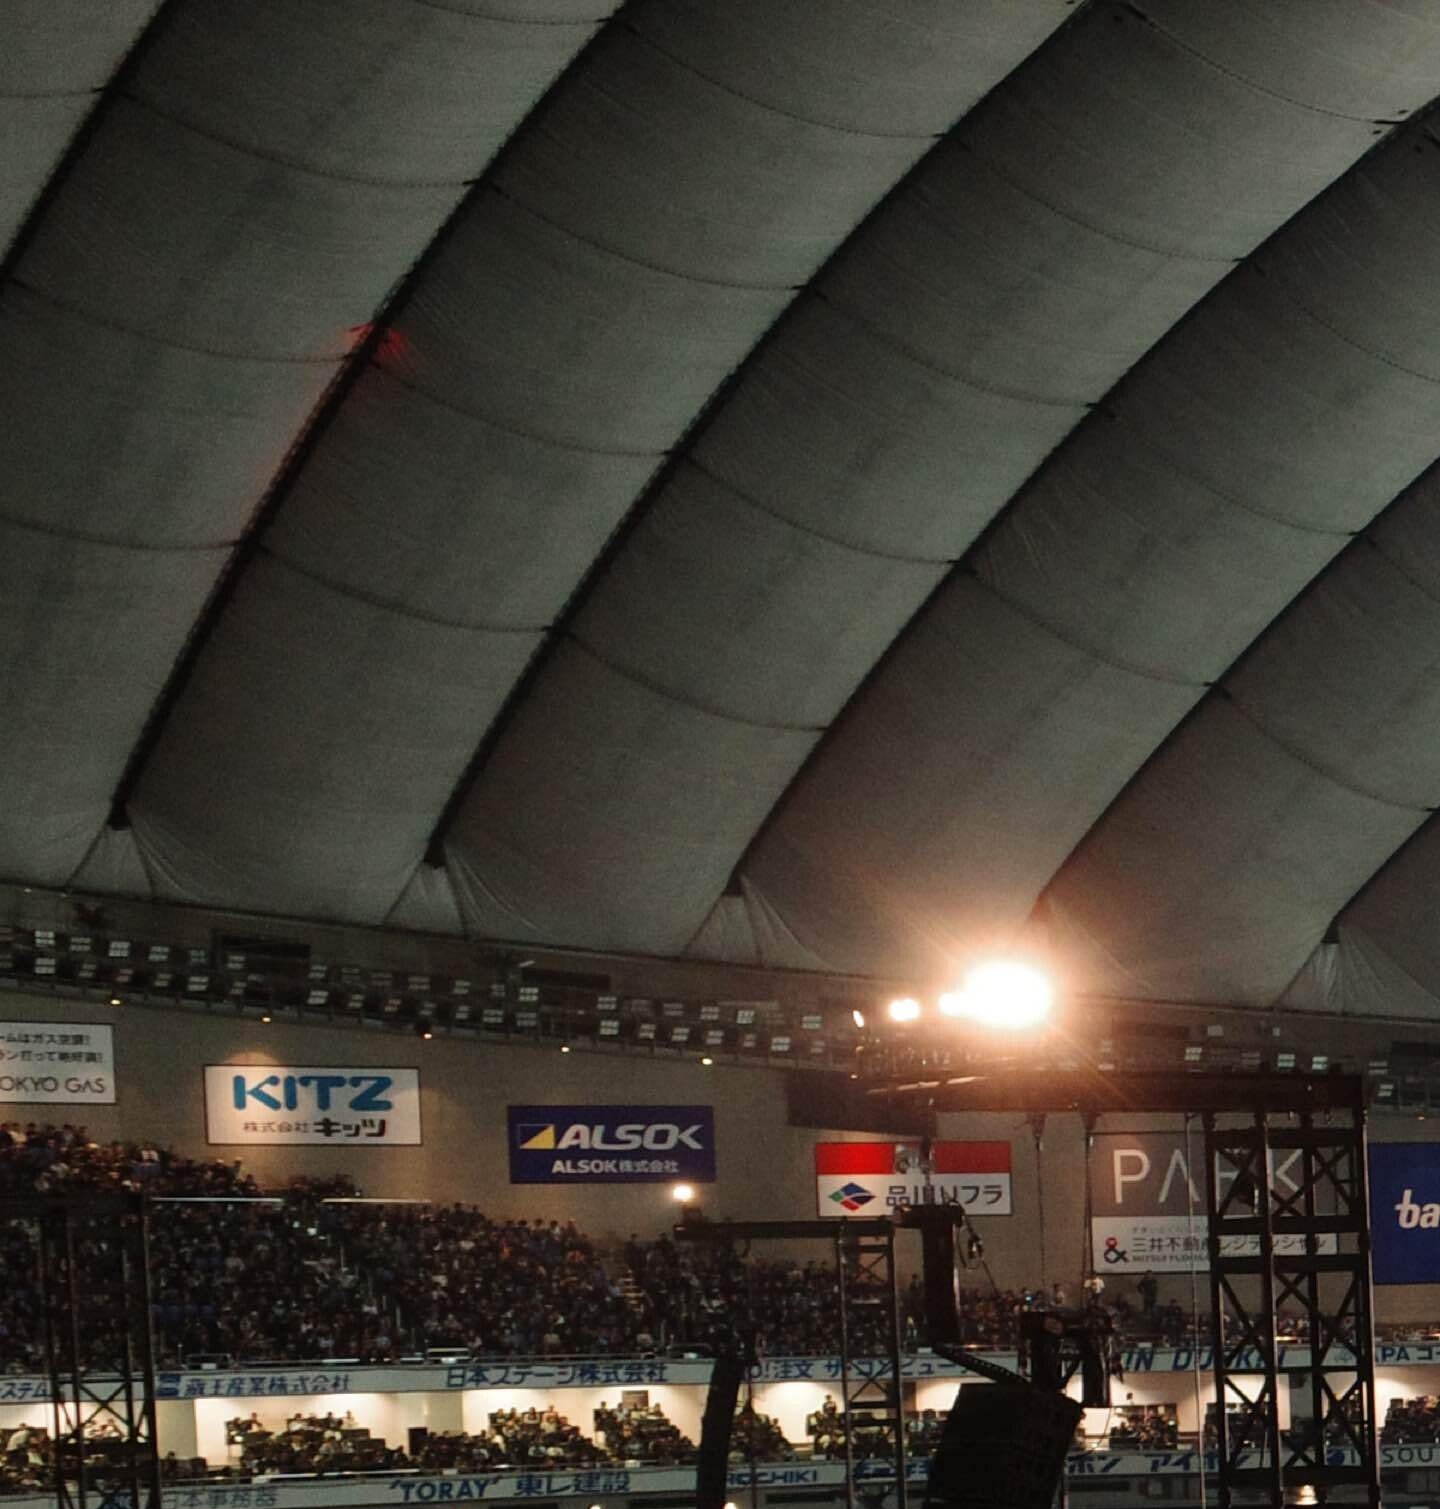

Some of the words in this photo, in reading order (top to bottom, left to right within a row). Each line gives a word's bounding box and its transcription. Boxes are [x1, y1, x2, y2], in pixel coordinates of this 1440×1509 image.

[0, 1076, 59, 1092] OKYO
[65, 1077, 105, 1093] GAS
[233, 1075, 393, 1111] KITZ
[556, 1123, 704, 1151] ALSOK
[446, 1363, 669, 1388] 日本ステージ株式会社
